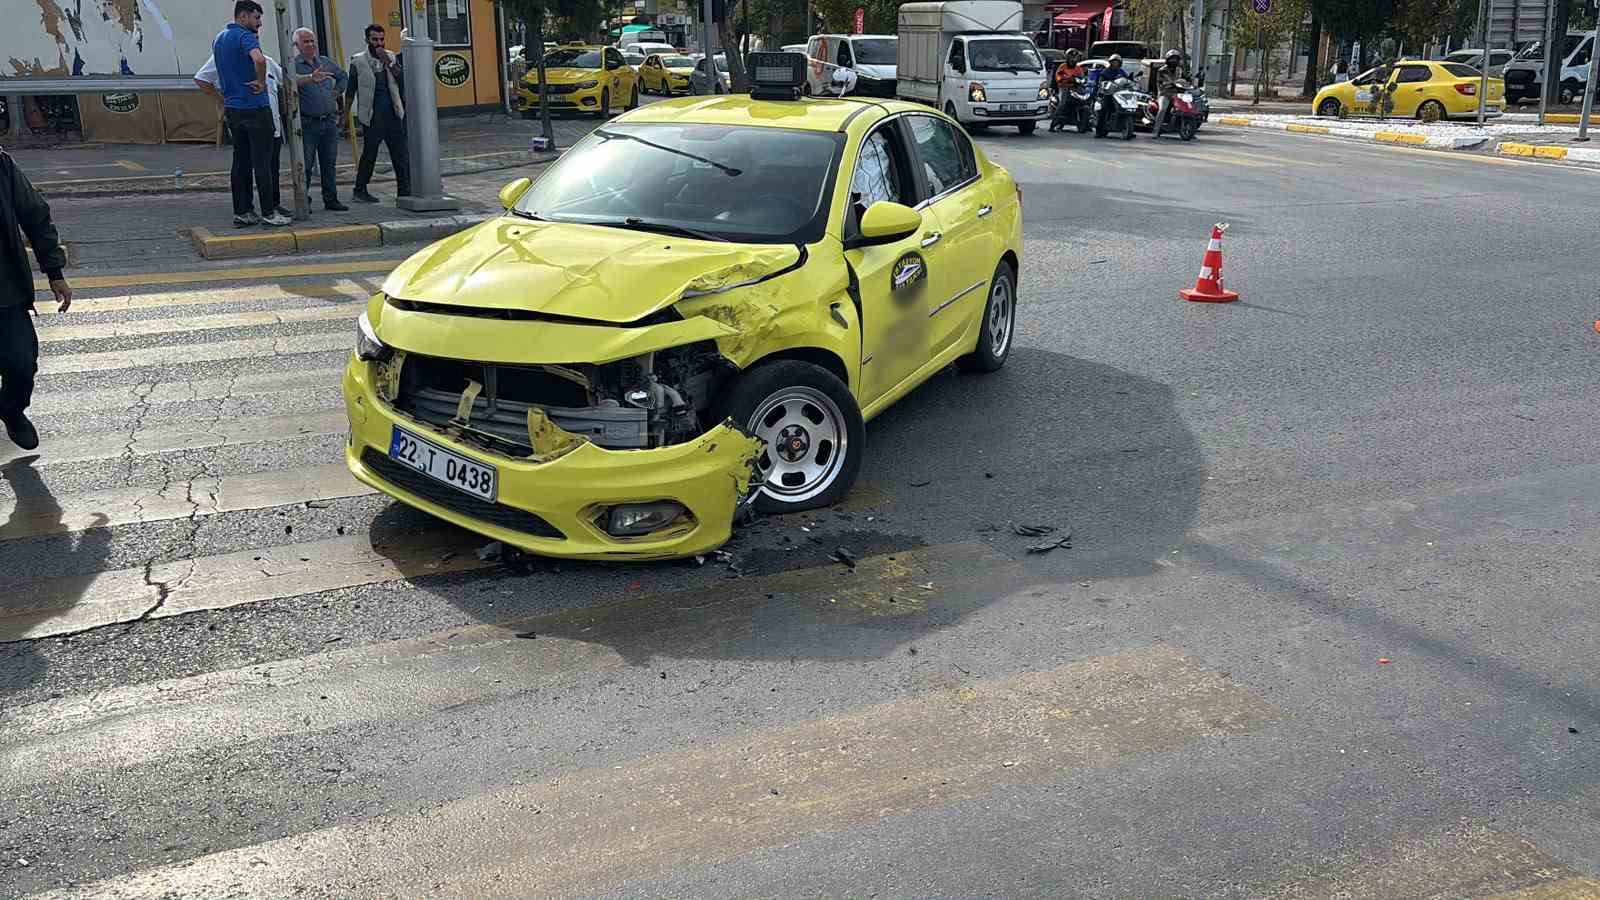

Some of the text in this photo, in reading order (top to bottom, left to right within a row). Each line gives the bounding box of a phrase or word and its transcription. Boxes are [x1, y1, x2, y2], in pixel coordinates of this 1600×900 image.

[399, 437, 491, 494] 22 T 0438
